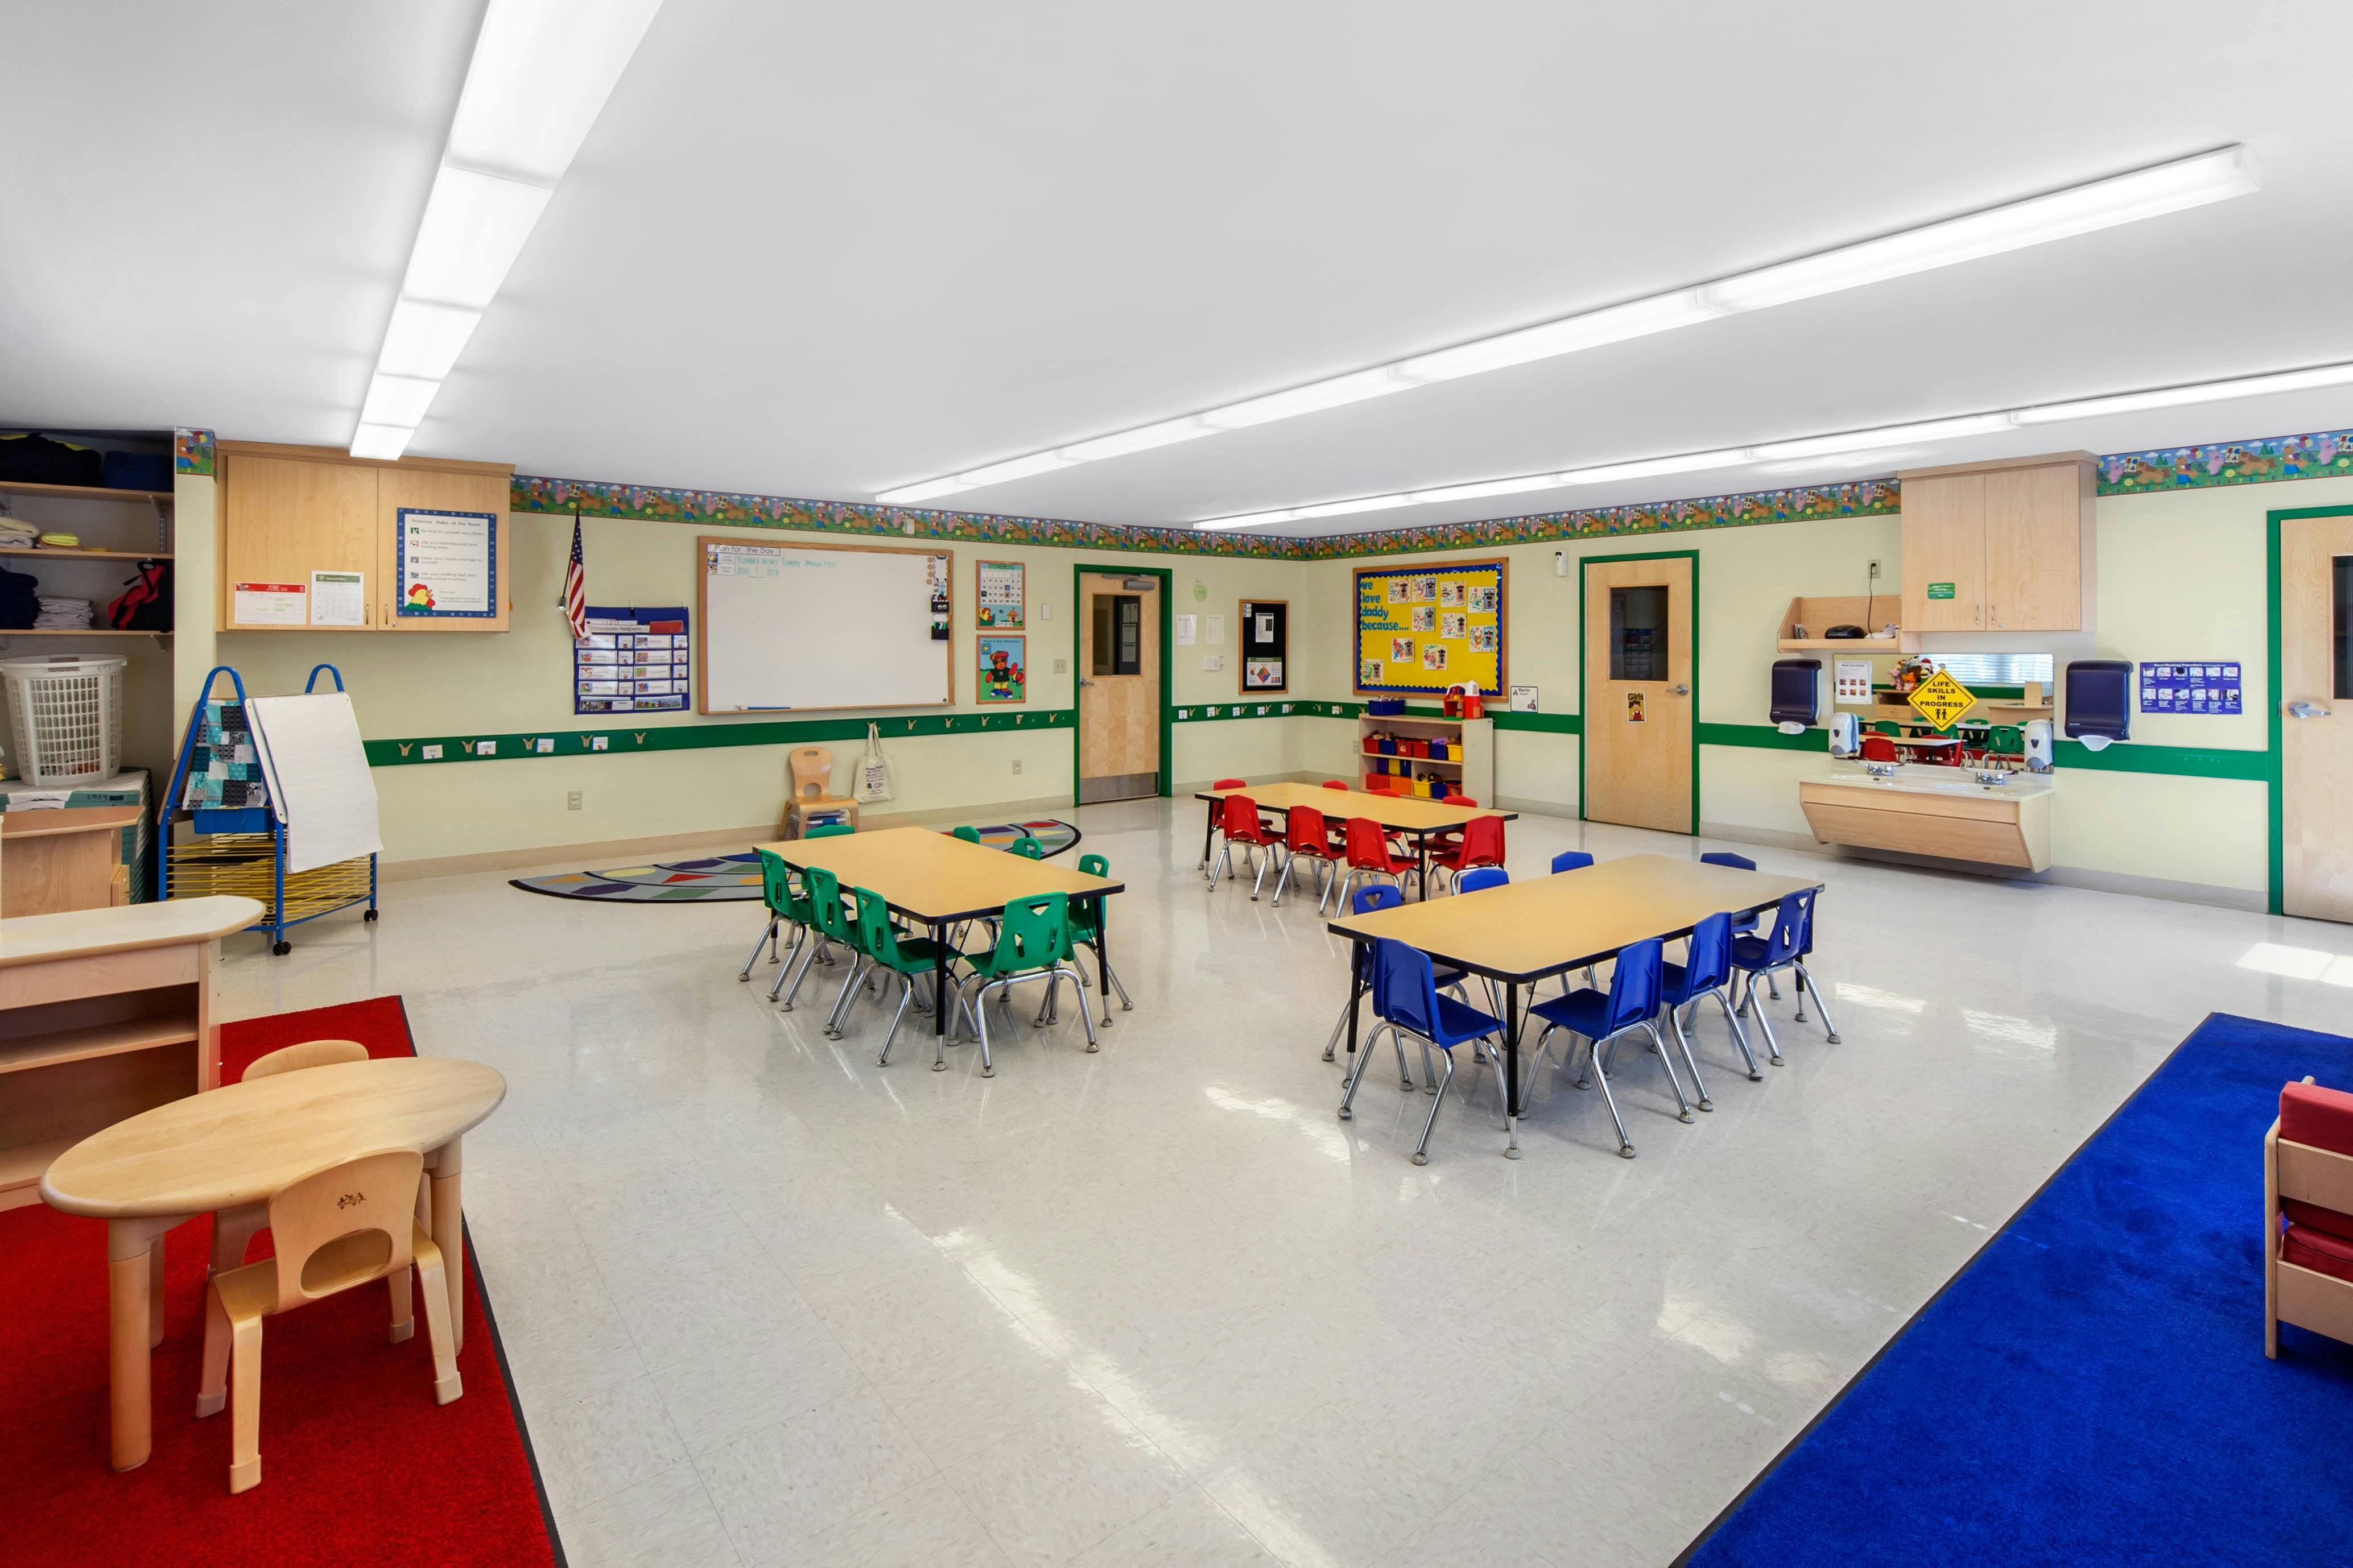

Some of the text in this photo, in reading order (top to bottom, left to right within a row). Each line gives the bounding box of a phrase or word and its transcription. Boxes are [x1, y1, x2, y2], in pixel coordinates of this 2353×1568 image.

[1361, 581, 1373, 590] we
[1363, 592, 1381, 603] love
[1361, 605, 1389, 620] daddy
